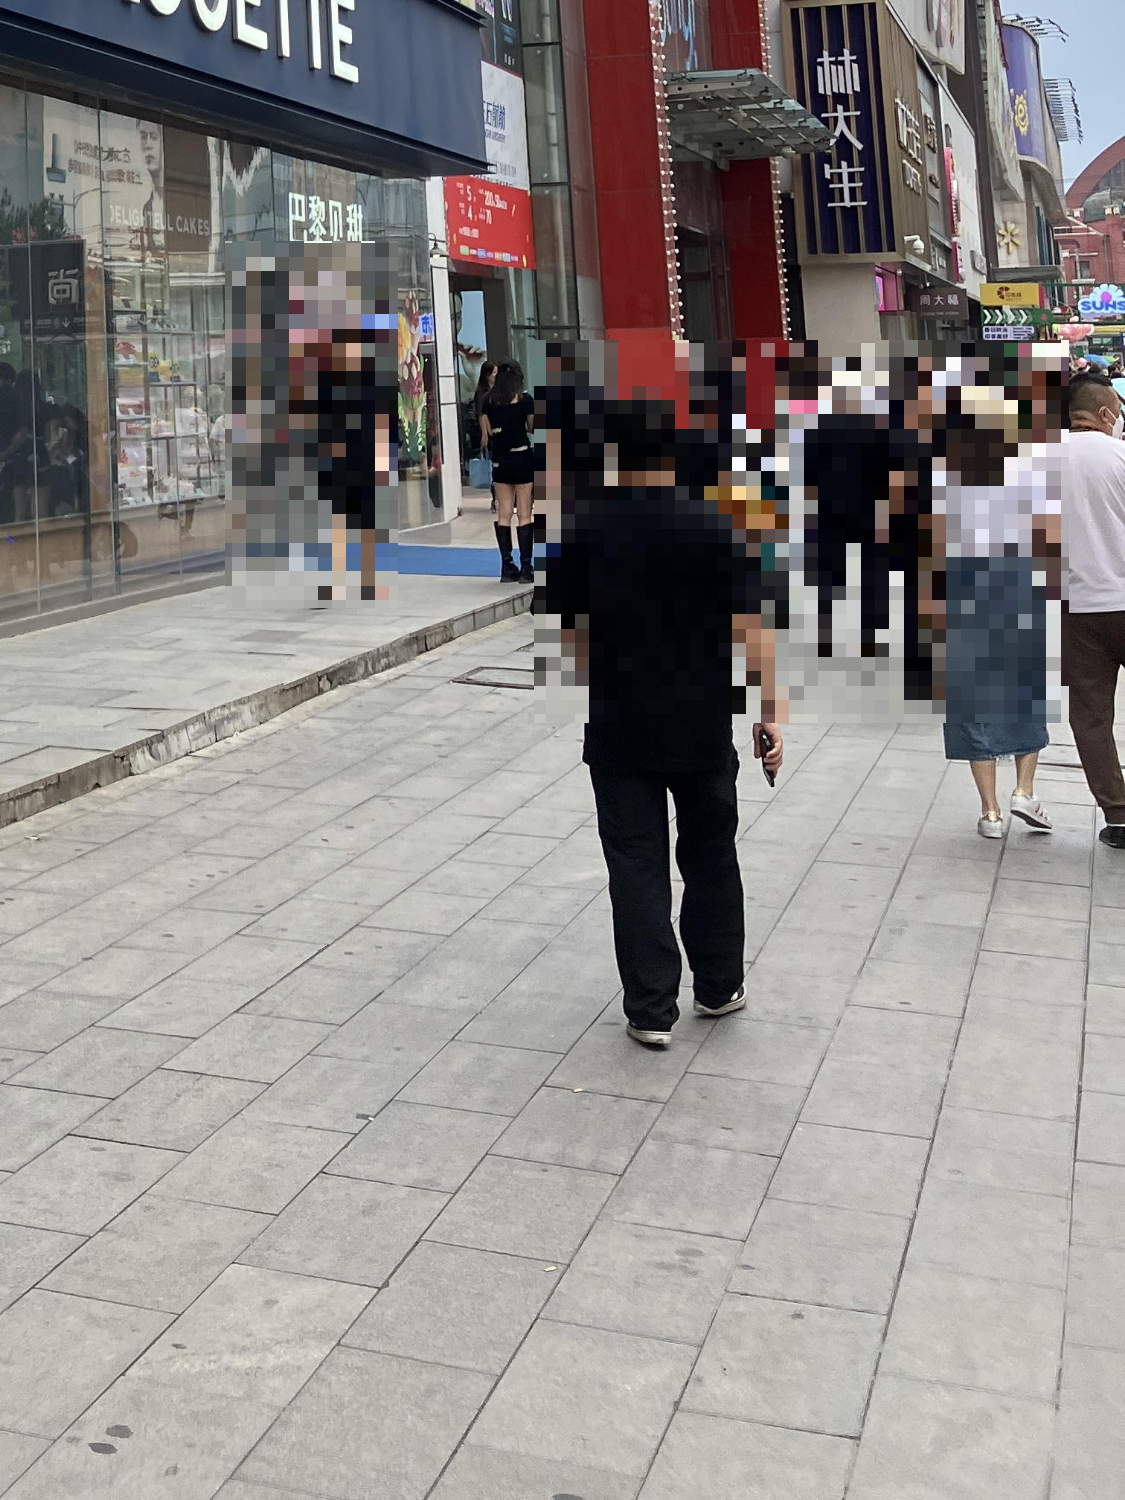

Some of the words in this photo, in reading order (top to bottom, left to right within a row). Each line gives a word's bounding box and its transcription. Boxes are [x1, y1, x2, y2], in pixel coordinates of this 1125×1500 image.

[816, 48, 868, 209] 林大生
[175, 215, 210, 236] CAKES
[288, 191, 364, 243] 巴黎贝甜
